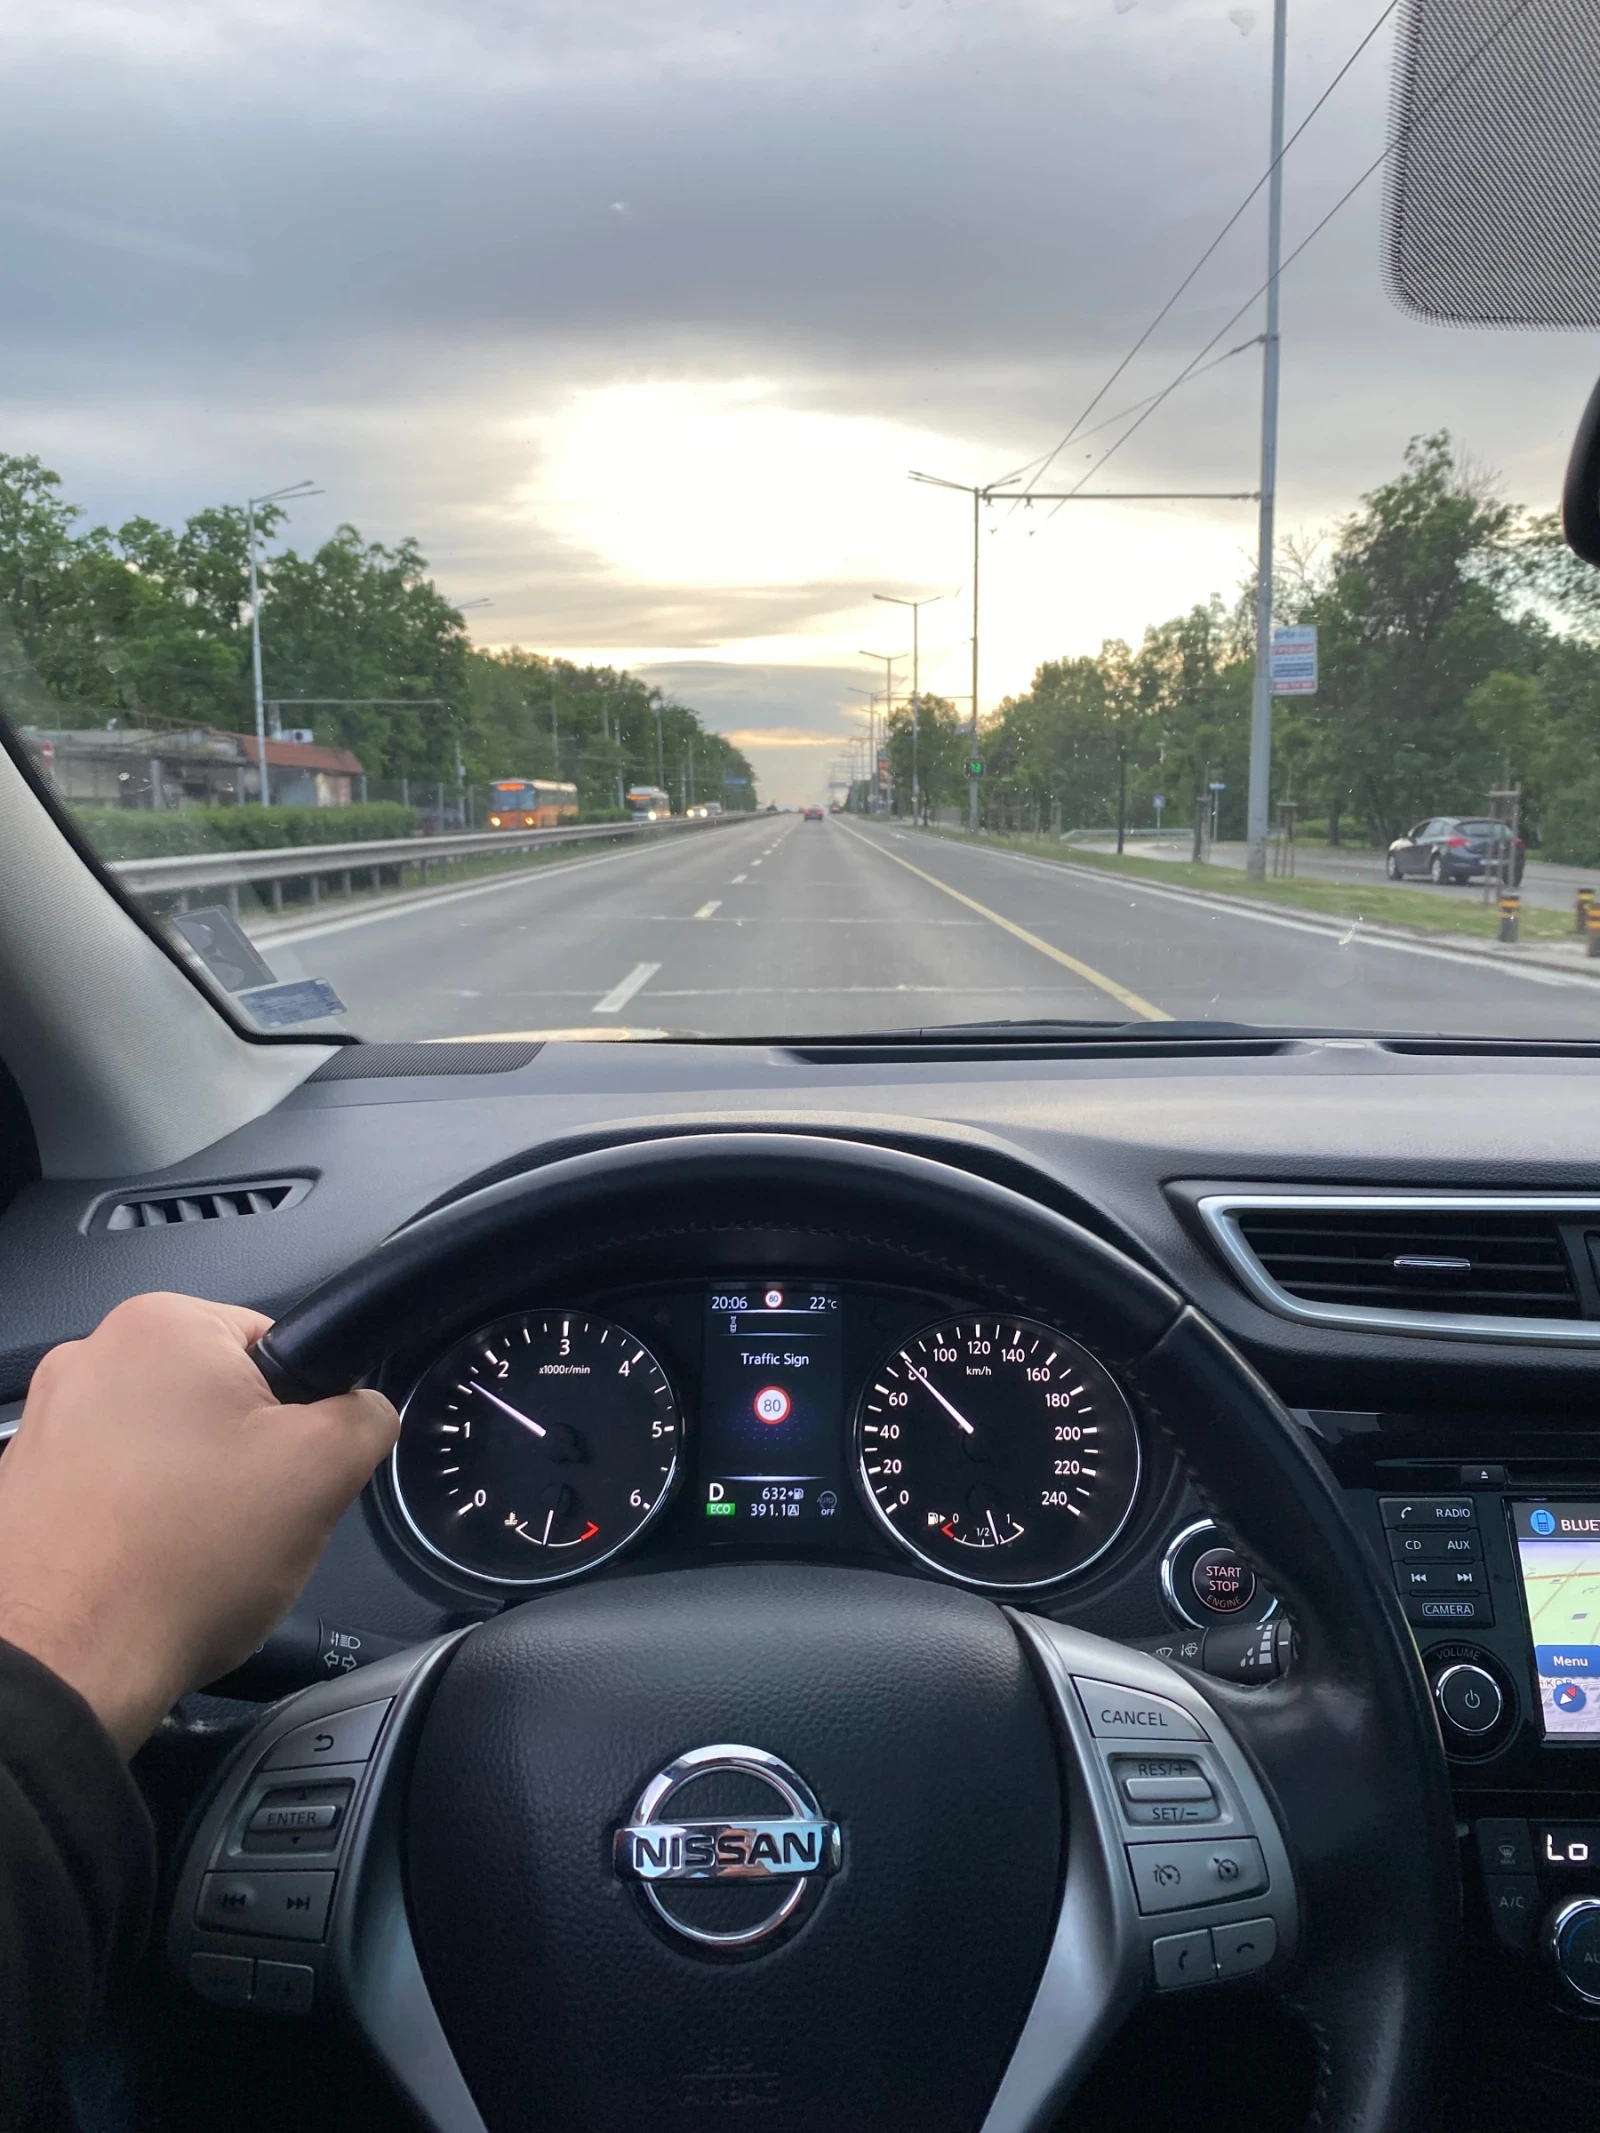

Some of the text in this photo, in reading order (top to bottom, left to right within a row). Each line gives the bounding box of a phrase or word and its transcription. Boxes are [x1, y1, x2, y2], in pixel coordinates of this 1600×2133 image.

[711, 1296, 748, 1310] 20:06
[559, 1338, 571, 1356] 3
[967, 1340, 992, 1355] 120
[741, 1353, 810, 1367] Traffic Sign
[933, 1348, 958, 1363] 100
[1001, 1348, 1026, 1363] 140
[497, 1360, 510, 1378] 2
[538, 1364, 591, 1375] x1000r/min
[618, 1360, 631, 1377] 4
[966, 1365, 992, 1376] km/h
[1026, 1367, 1051, 1382] 160
[763, 1398, 782, 1413] 80
[888, 1391, 909, 1407] 60
[1045, 1392, 1070, 1408] 180
[463, 1421, 471, 1438] 1
[652, 1420, 663, 1438] 5
[879, 1424, 900, 1440] 40
[1054, 1426, 1081, 1441] 200
[883, 1458, 902, 1474] 20
[1054, 1459, 1080, 1475] 220
[474, 1489, 487, 1507] 0
[630, 1489, 642, 1507] 6
[709, 1482, 725, 1501] D
[762, 1487, 787, 1500] 632
[899, 1489, 910, 1505] 0
[1041, 1491, 1068, 1506] 240
[710, 1504, 731, 1515] ECO
[750, 1503, 786, 1517] 391.1
[820, 1507, 836, 1516] OFF
[1435, 1508, 1471, 1518] RADIO
[952, 1512, 960, 1524] 0
[1006, 1513, 1011, 1524] 1
[976, 1528, 990, 1537] 1/2
[1405, 1540, 1422, 1550] CD
[1447, 1540, 1471, 1550] AUX
[1205, 1565, 1242, 1578] START
[1208, 1579, 1240, 1592] STOP
[1206, 1594, 1242, 1608] ENGINE
[1424, 1604, 1472, 1616] CAMERA
[1436, 1648, 1481, 1661] VOLUME
[1552, 1655, 1589, 1667] Menu
[1100, 1709, 1169, 1727] CANCEL
[1138, 1763, 1188, 1776] RES/+
[266, 1811, 318, 1826] ENTER
[633, 1831, 817, 1868] NISSAN
[1546, 1833, 1589, 1861] Lo
[1499, 1896, 1526, 1909] A/C
